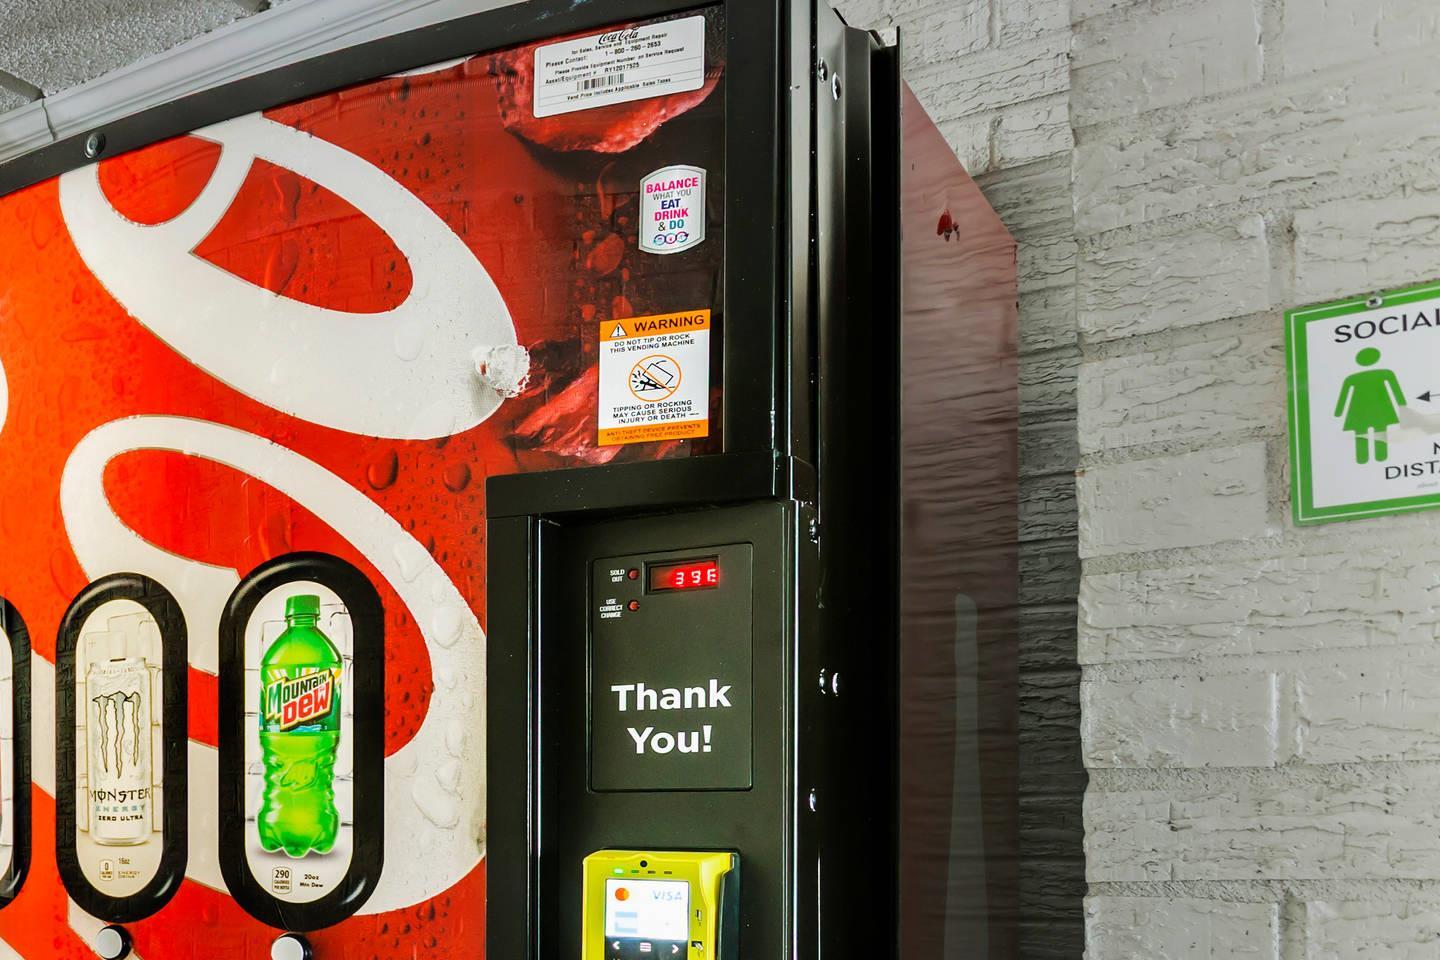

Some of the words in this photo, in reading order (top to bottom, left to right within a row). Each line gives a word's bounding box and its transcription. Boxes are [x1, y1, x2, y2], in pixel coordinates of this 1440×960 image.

[646, 177, 698, 193] BALANCE
[653, 192, 673, 200] WHAT
[661, 198, 681, 209] EAT
[655, 208, 688, 221] DRINK
[658, 221, 666, 231] &
[669, 219, 684, 229] DO
[634, 315, 704, 332] WARNING
[627, 343, 659, 351] VENDING
[662, 339, 694, 348] MACHINE
[657, 400, 692, 408] ROCKING
[631, 409, 656, 417] CAUSE
[659, 406, 692, 414] SERIOUS
[1385, 460, 1440, 480] DIST
[611, 679, 732, 712] Thank
[627, 725, 712, 754] You!
[275, 870, 289, 878] 290
[653, 890, 682, 901] VISA
